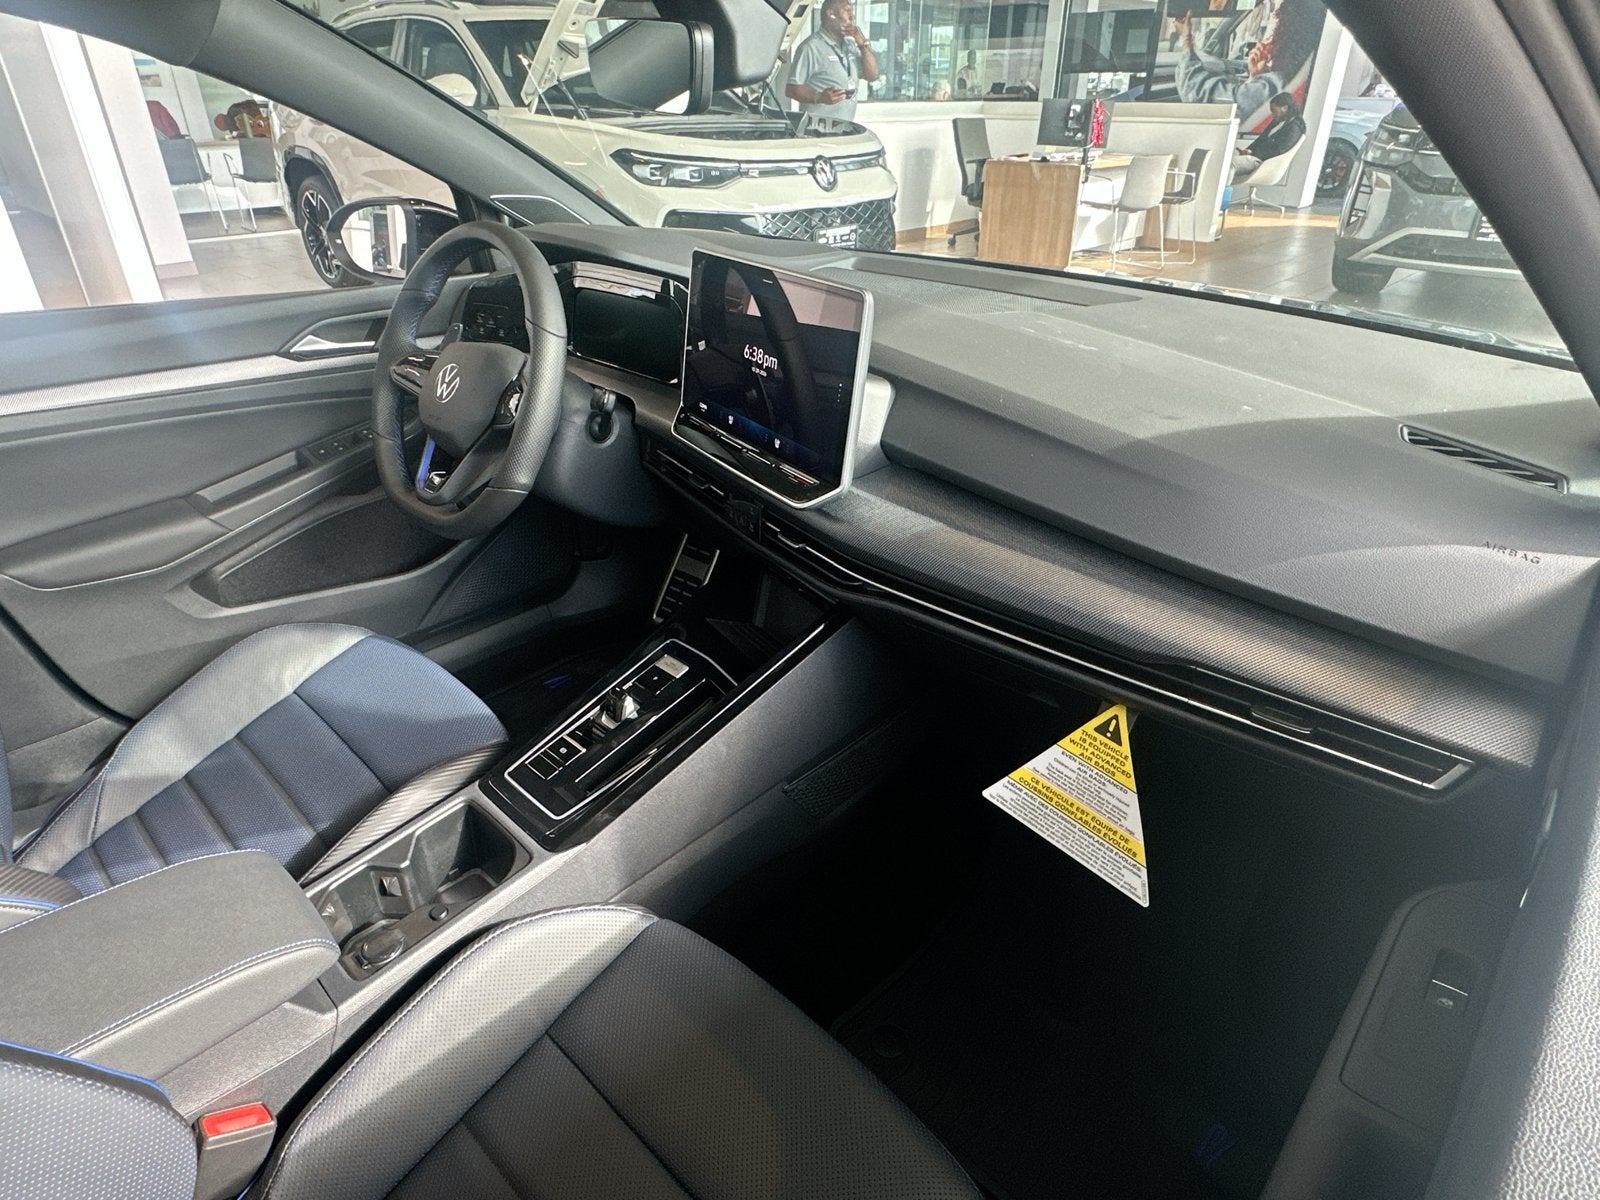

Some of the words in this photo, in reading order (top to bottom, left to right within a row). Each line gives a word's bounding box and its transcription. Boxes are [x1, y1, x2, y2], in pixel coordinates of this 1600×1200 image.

[1482, 541, 1541, 565] AIRBAG
[1068, 737, 1088, 752] WITH
[1089, 750, 1132, 779] ADVANCED
[1078, 735, 1087, 744] IS
[1088, 741, 1125, 767] EQUIPPED
[1081, 729, 1097, 742] THIS
[1098, 739, 1129, 761] VEHICLE
[1061, 750, 1077, 762] EVEN
[1078, 760, 1093, 773] WITH
[1094, 771, 1128, 794] ADVANCED
[1078, 751, 1092, 762] AIR
[1093, 760, 1116, 777] BAGS
[1018, 775, 1053, 802] COUSSINS
[1054, 799, 1102, 834] GONFLABLES
[1102, 831, 1137, 858] ÉVOLUÉS
[1030, 775, 1040, 786] CE
[1040, 782, 1074, 808] VÉHICULE
[1075, 805, 1089, 818] EST
[1090, 815, 1118, 836] ÉQUIPÉ
[1118, 833, 1130, 844] DE
